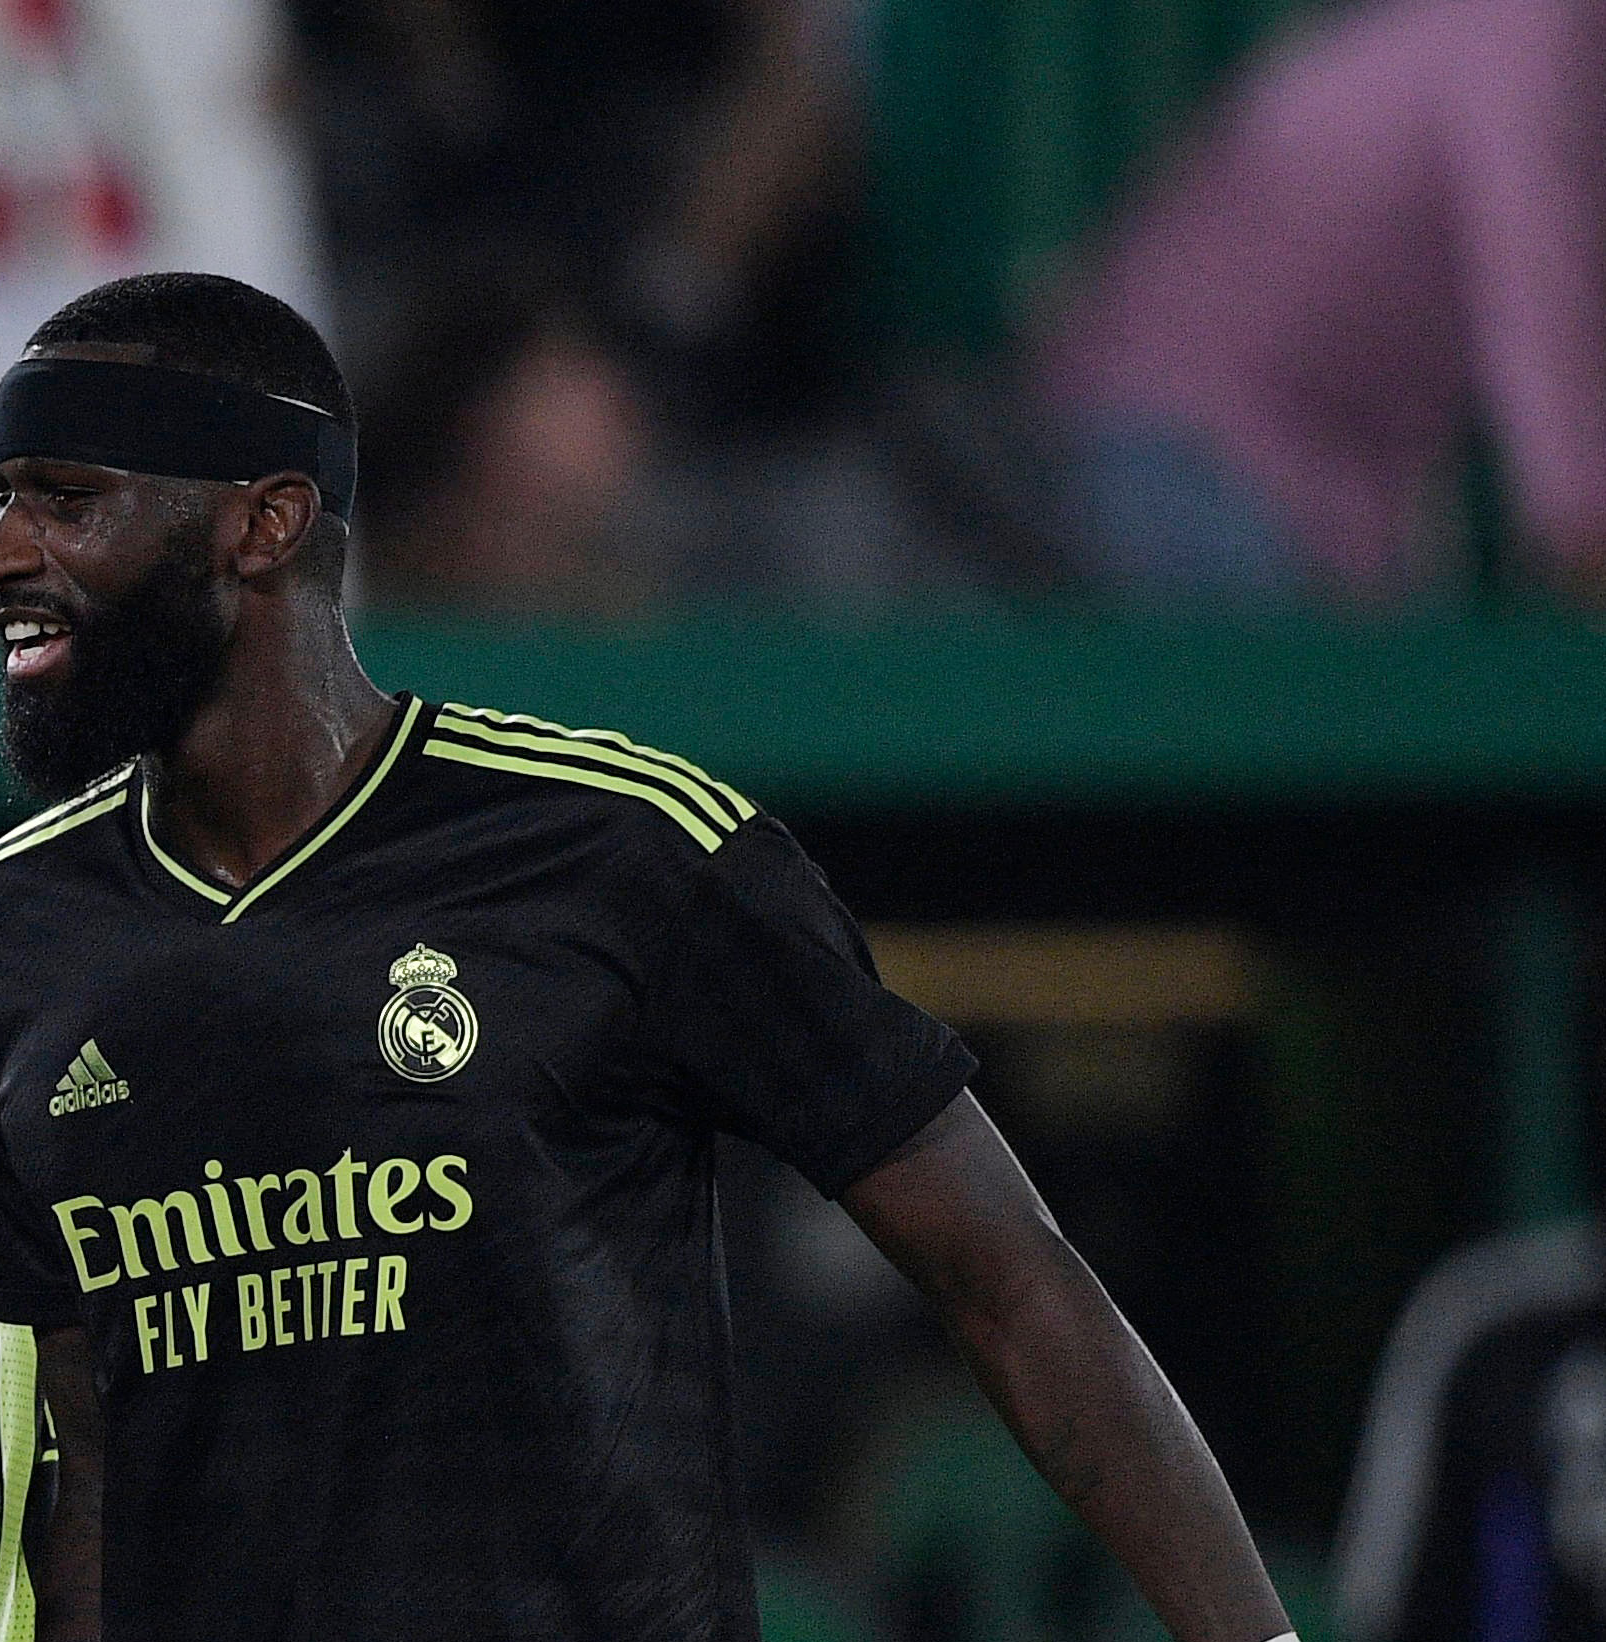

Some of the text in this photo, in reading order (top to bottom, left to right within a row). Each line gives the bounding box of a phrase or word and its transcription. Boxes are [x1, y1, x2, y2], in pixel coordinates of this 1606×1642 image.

[49, 1080, 130, 1117] adidas
[51, 1146, 474, 1294] Emirates
[134, 1254, 407, 1374] FLY BETTER
